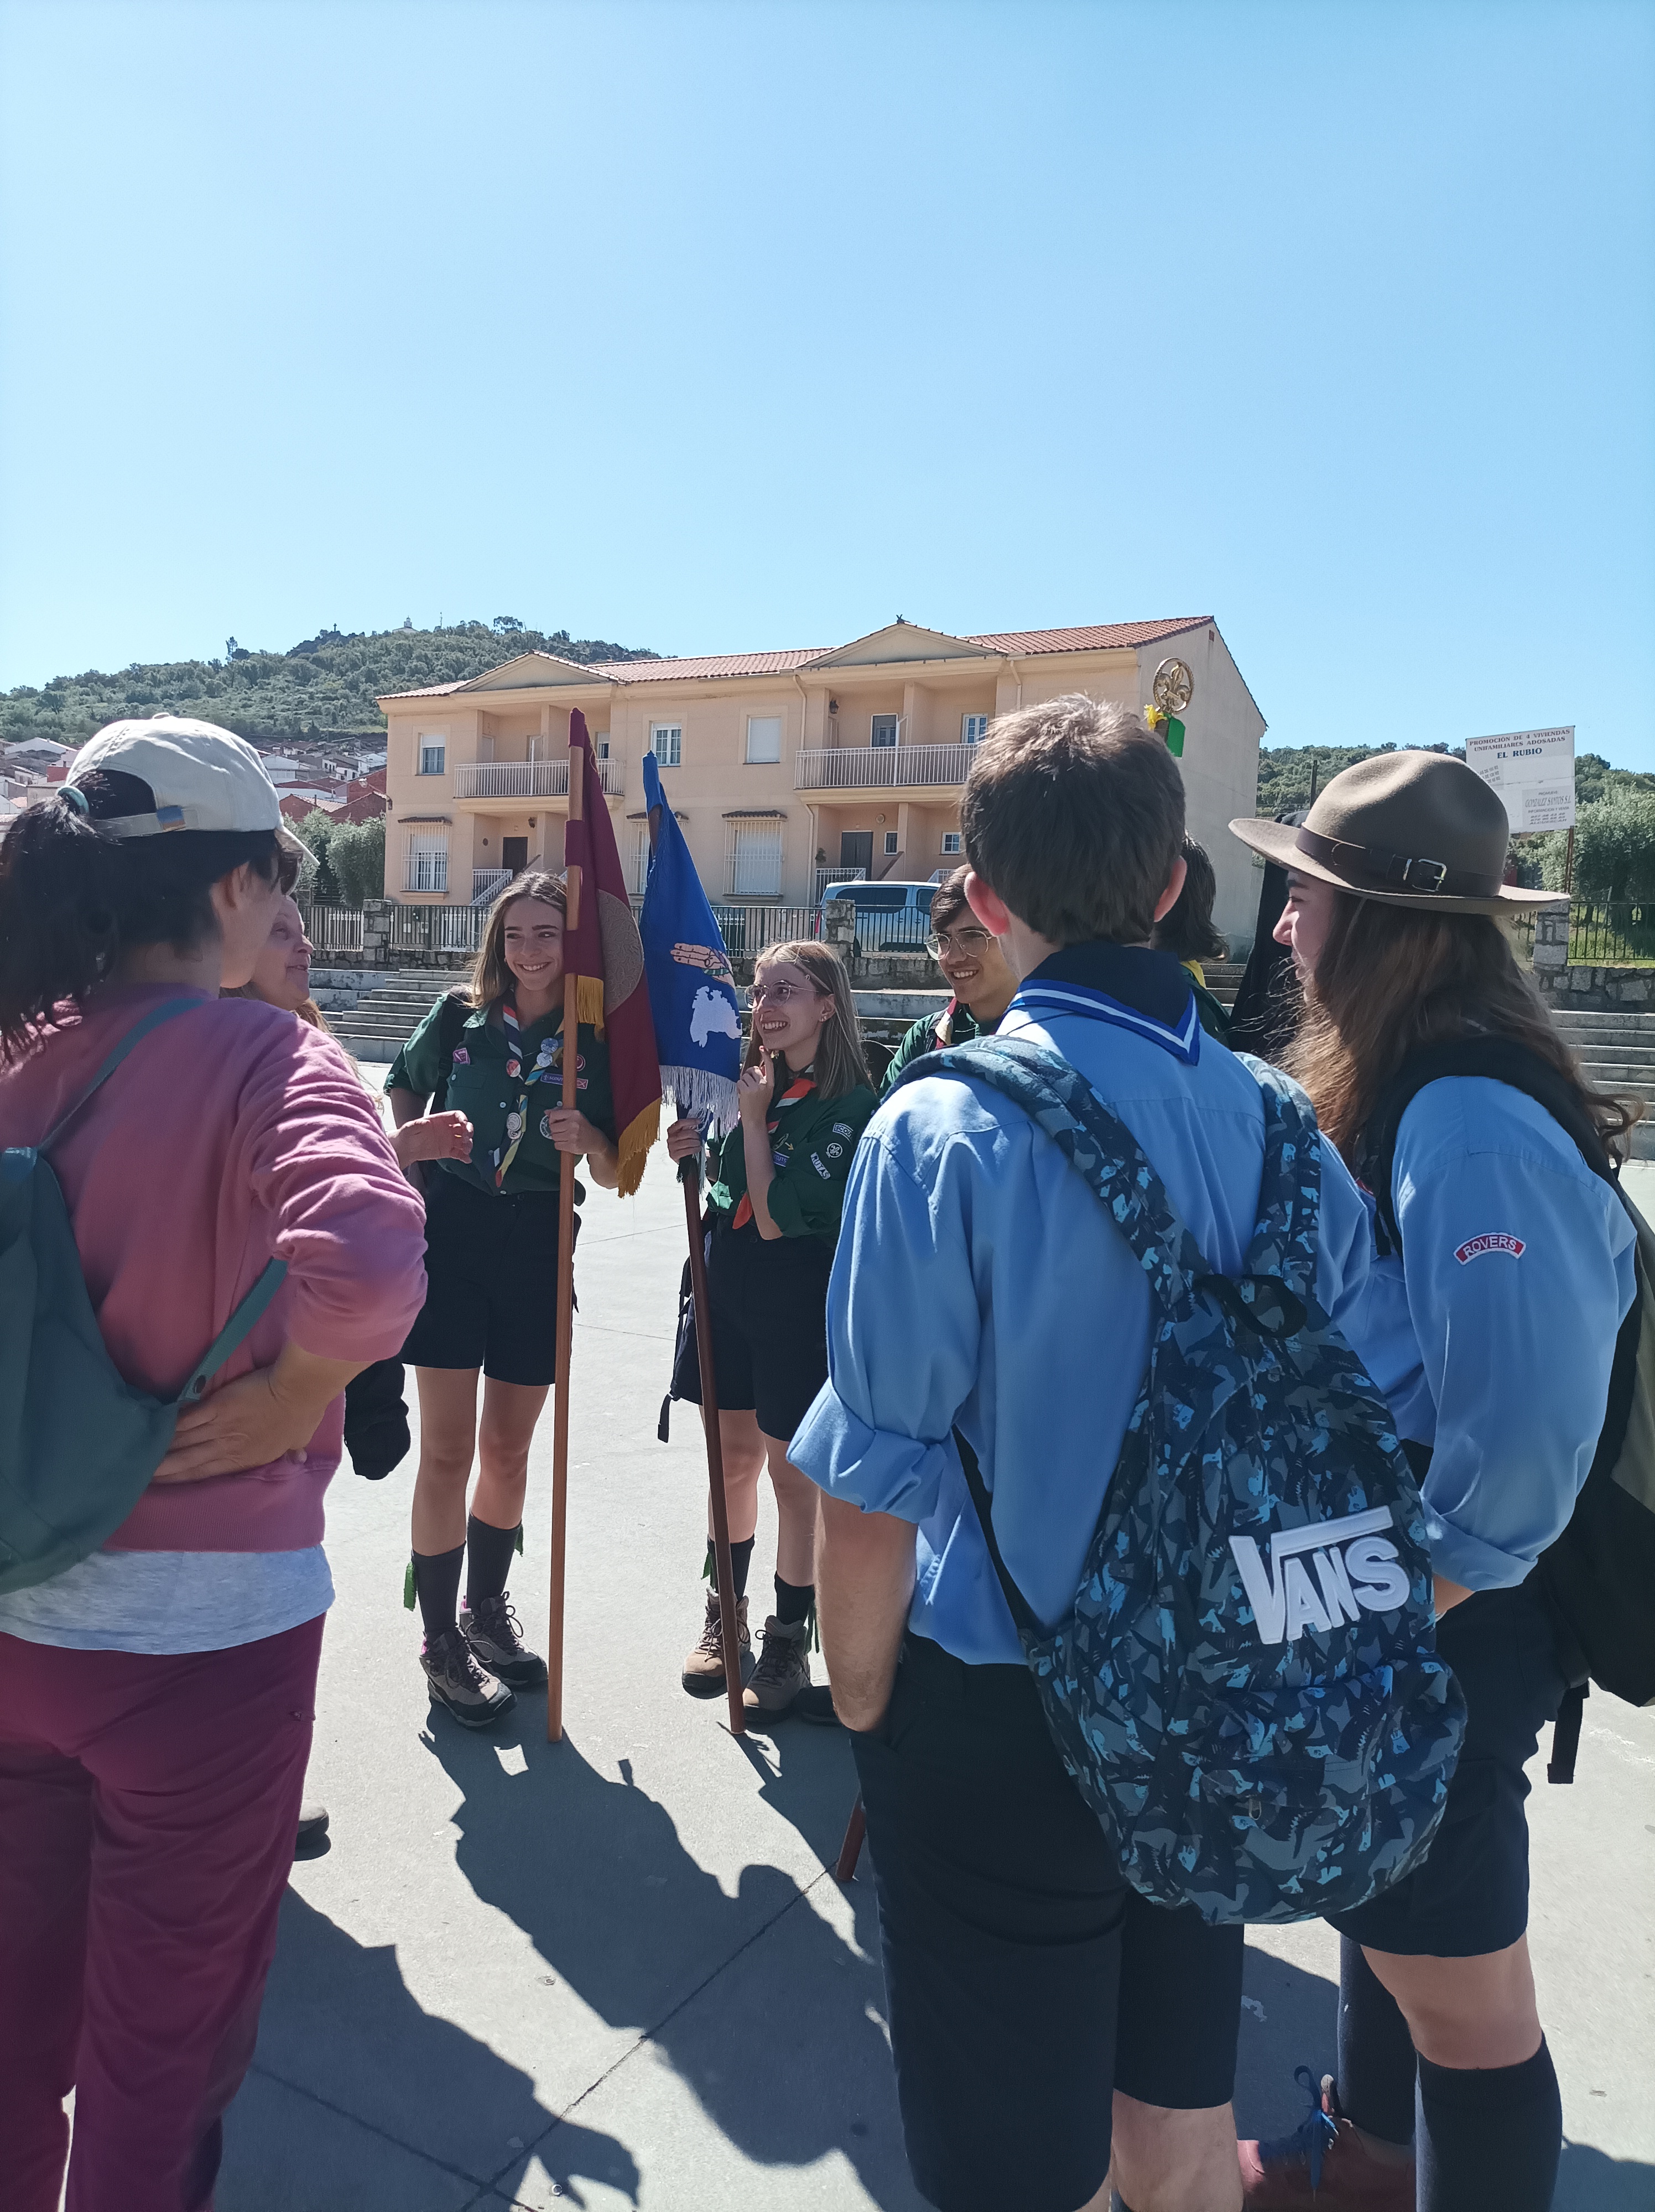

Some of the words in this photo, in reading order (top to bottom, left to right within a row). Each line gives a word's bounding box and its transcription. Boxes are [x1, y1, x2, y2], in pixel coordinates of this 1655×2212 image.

[1470, 737, 1511, 746] PROMOCIÓN
[1533, 729, 1570, 739] VIVIENDAS
[1474, 741, 1523, 752] UNIFAMILIARES
[1527, 736, 1565, 745] ADOSADAS
[1512, 748, 1543, 757] RUBIO
[811, 1155, 829, 1178] RUTAS
[1463, 1236, 1517, 1256] ROVERS
[1228, 1505, 1411, 1645] VANS
